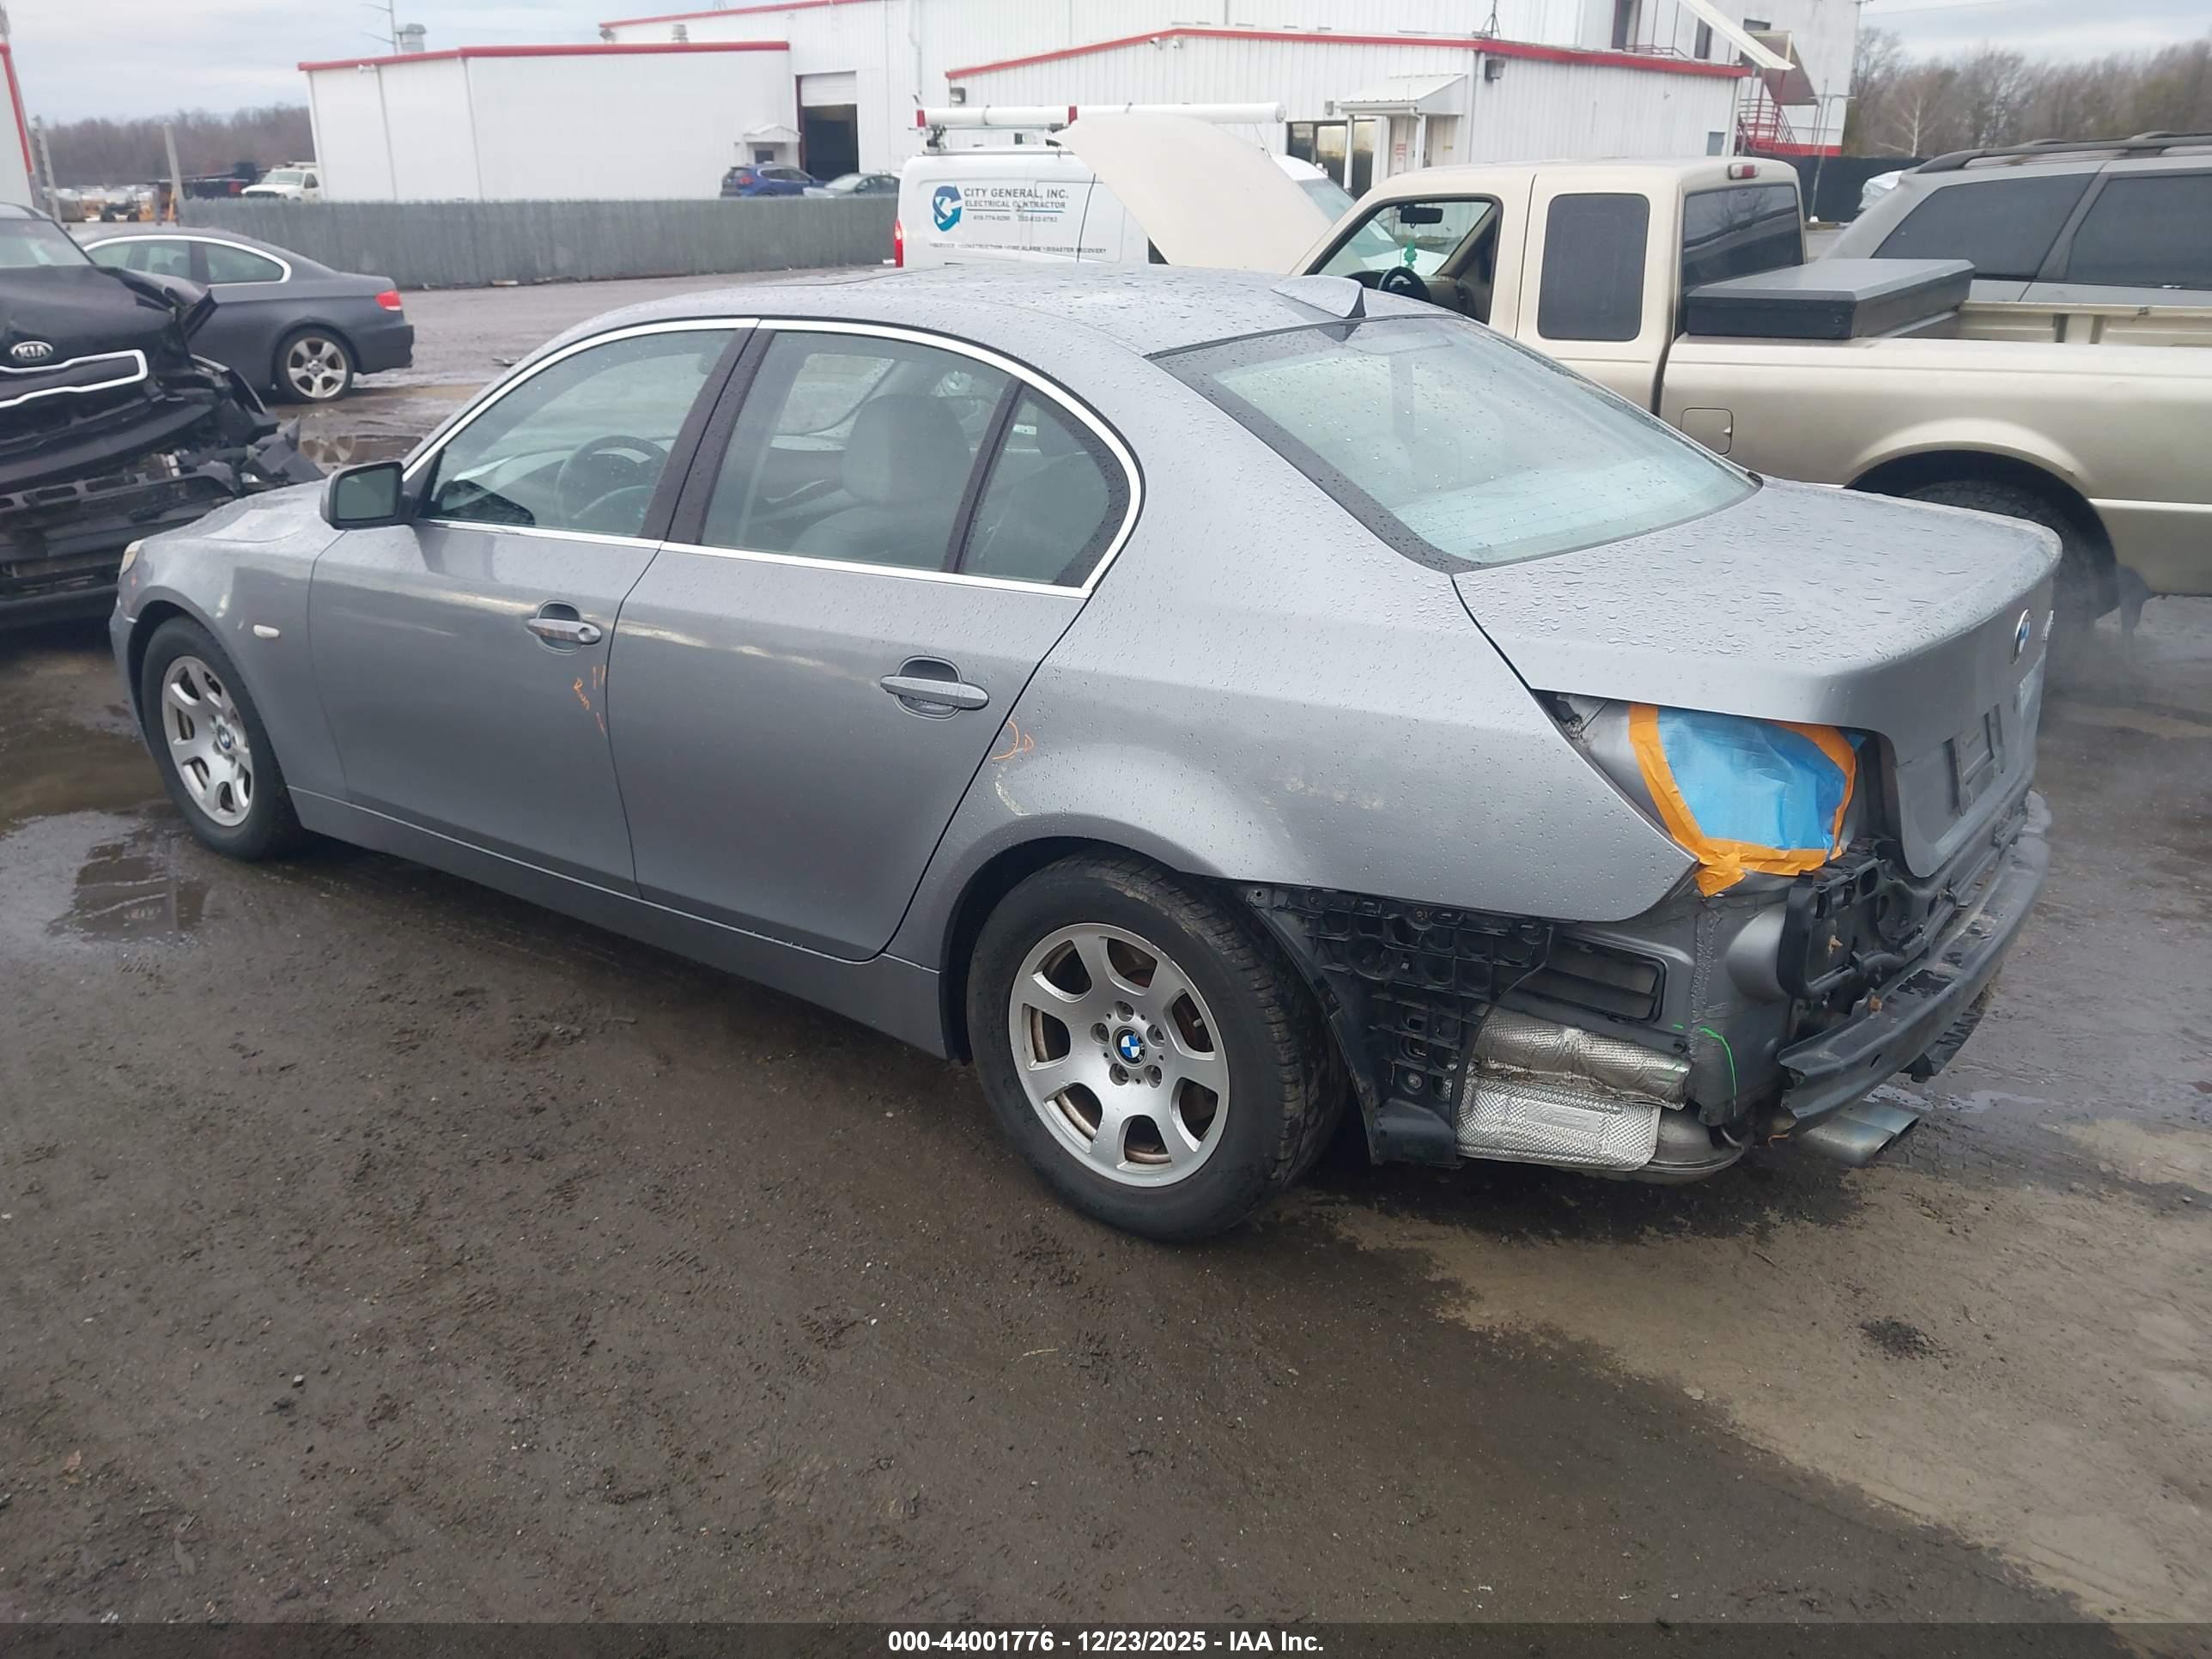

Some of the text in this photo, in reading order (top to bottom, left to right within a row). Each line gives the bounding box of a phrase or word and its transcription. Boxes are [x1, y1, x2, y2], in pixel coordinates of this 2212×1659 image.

[963, 188, 1069, 199] CITY GENERAL, INC.
[17, 344, 47, 357] KIA
